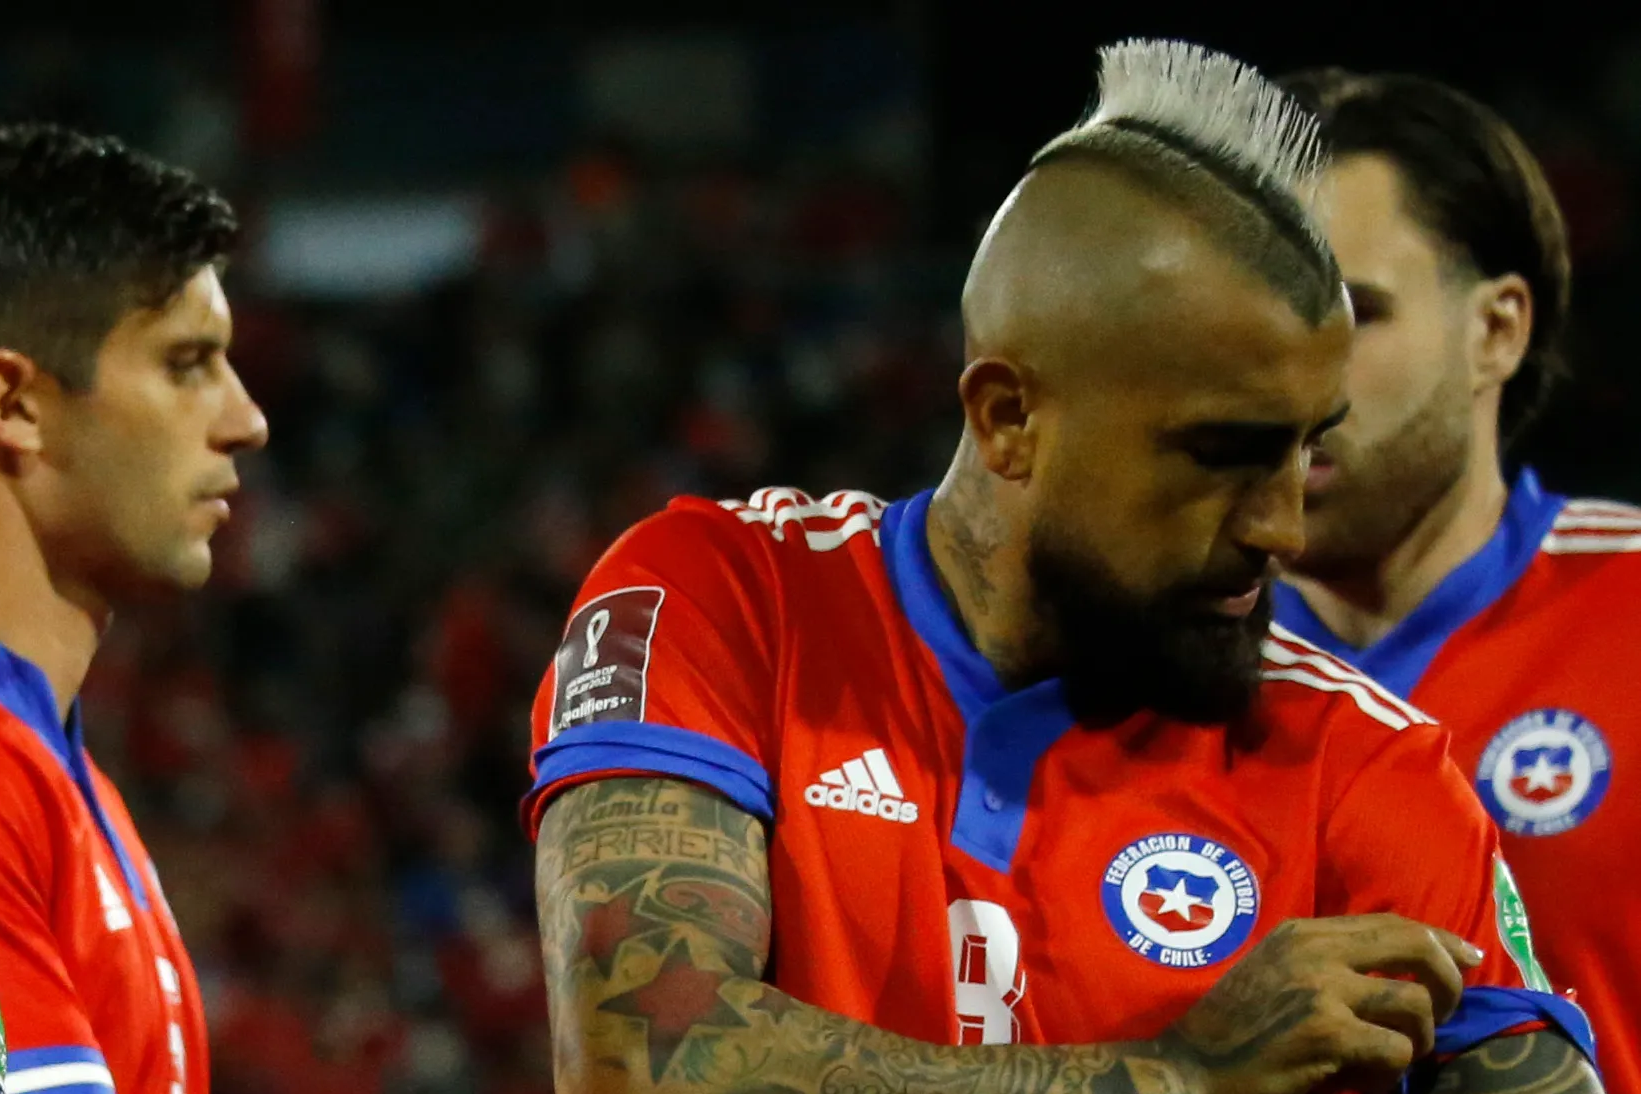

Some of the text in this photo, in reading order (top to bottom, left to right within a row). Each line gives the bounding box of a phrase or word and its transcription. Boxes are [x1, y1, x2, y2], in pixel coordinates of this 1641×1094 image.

[804, 783, 918, 824] adidas
[1105, 835, 1255, 916] FEDERACION DE FUTBOL
[1128, 933, 1209, 968] DE CHILE
